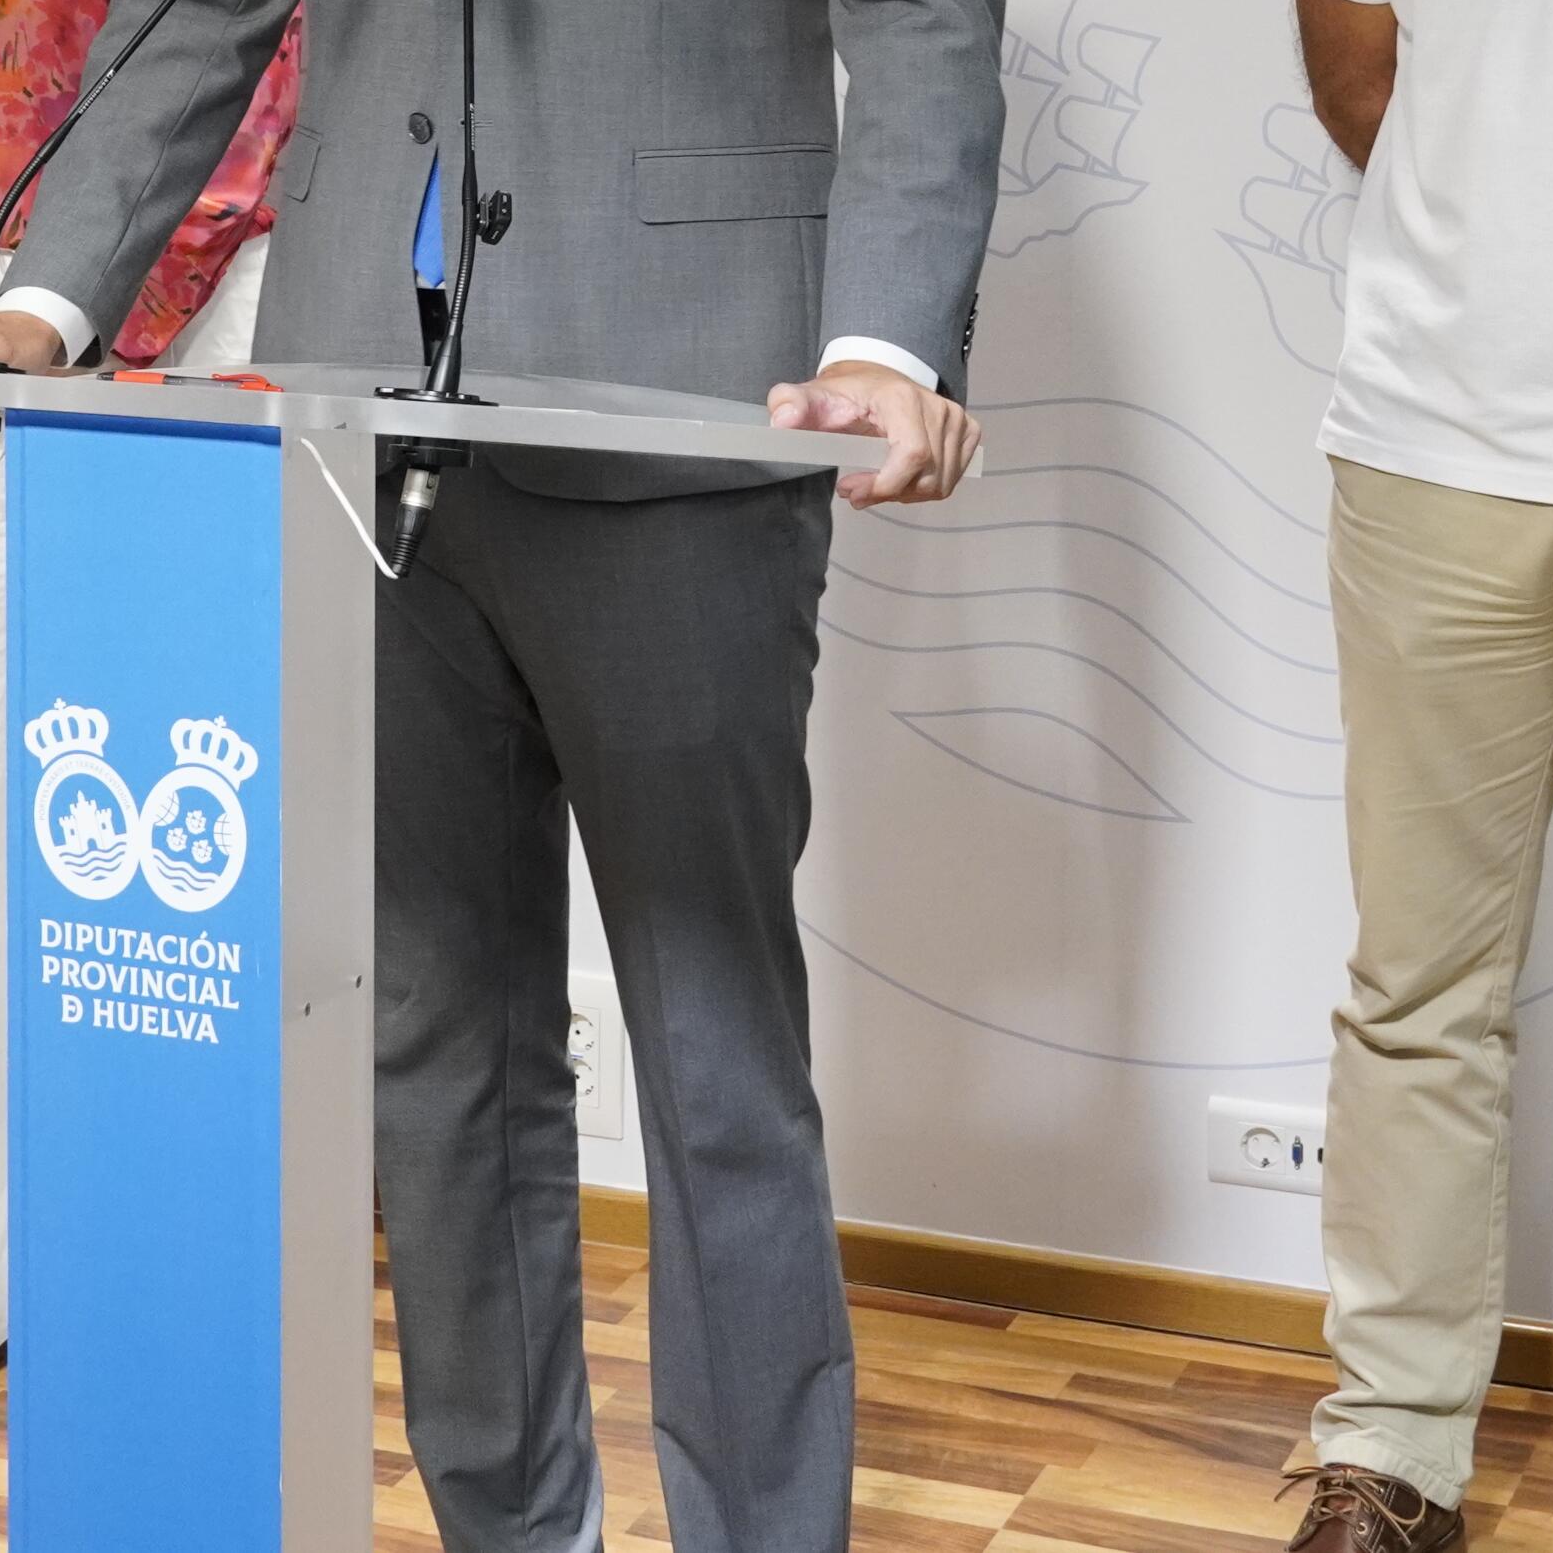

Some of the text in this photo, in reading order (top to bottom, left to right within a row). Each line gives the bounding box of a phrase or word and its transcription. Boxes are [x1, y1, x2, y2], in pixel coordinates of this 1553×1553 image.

[39, 918, 241, 973] DIPUTACIÓN
[41, 955, 239, 1010] PROVINCIAL
[93, 998, 219, 1044] HUELVA
